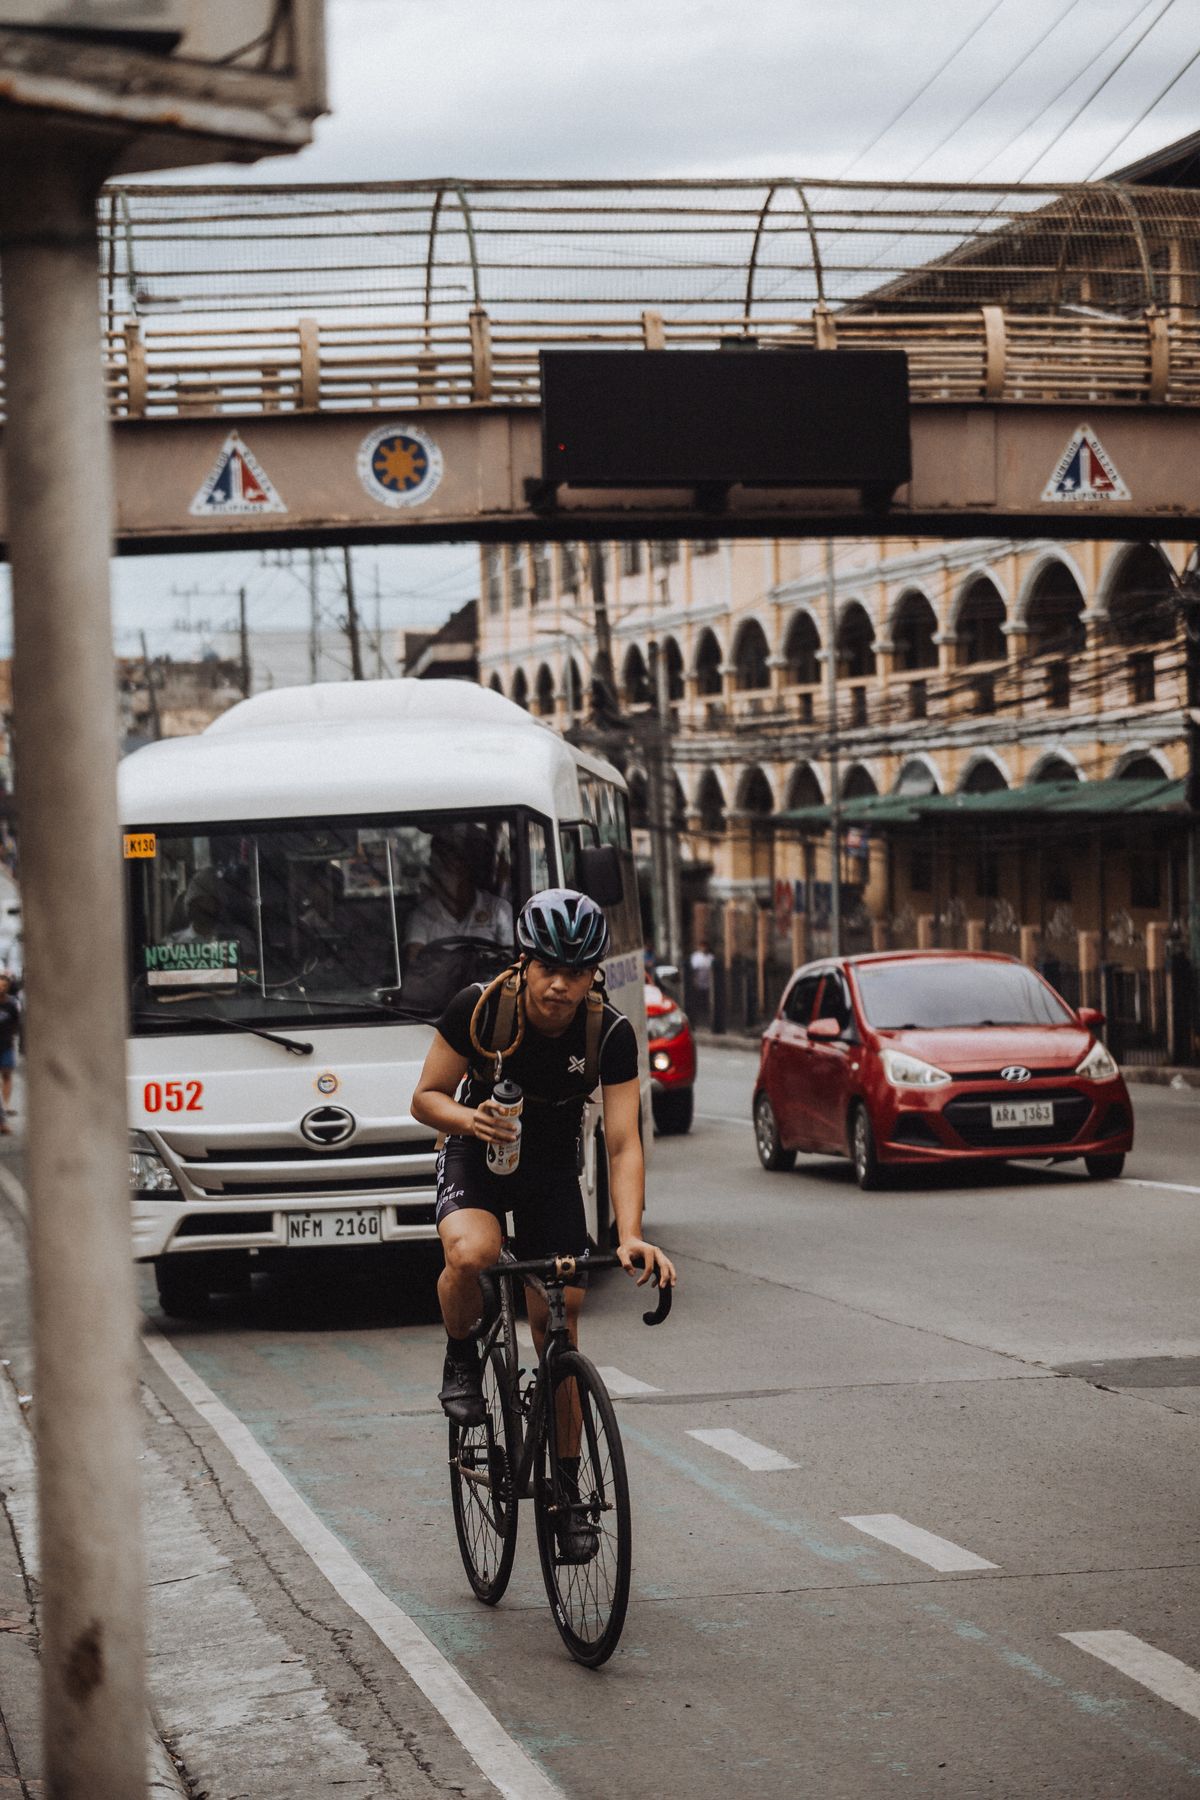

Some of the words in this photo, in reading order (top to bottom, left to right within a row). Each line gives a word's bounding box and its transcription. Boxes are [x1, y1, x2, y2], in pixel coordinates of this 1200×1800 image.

[130, 839, 154, 852] K130
[144, 1080, 204, 1113] 052
[996, 1108, 1017, 1121] ARA
[1022, 1106, 1050, 1121] 1363
[291, 1219, 322, 1238] NFM
[335, 1217, 378, 1236] 2160
